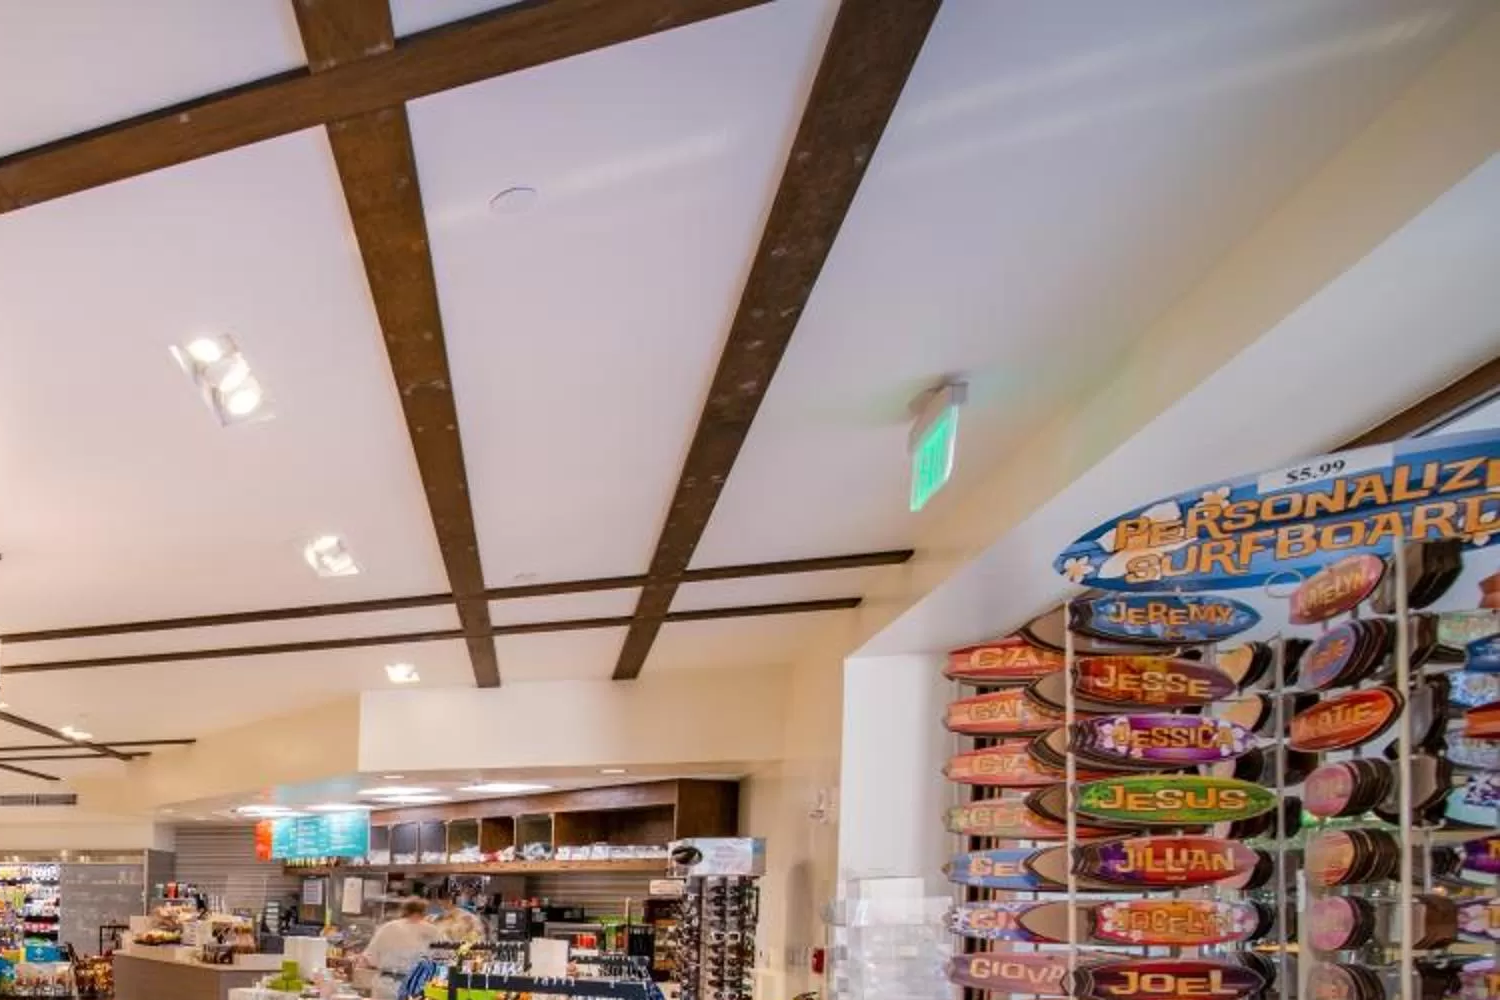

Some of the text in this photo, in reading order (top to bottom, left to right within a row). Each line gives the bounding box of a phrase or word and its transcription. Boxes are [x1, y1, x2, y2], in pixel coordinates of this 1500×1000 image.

[1285, 458, 1346, 485] $5.99
[1107, 601, 1234, 626] JEREMY
[1094, 664, 1213, 698] JESSE
[1111, 722, 1235, 748] JESSICA
[1099, 784, 1247, 812] JESUS
[1115, 847, 1236, 873] JILLIAN
[1109, 969, 1240, 995] JOEL
